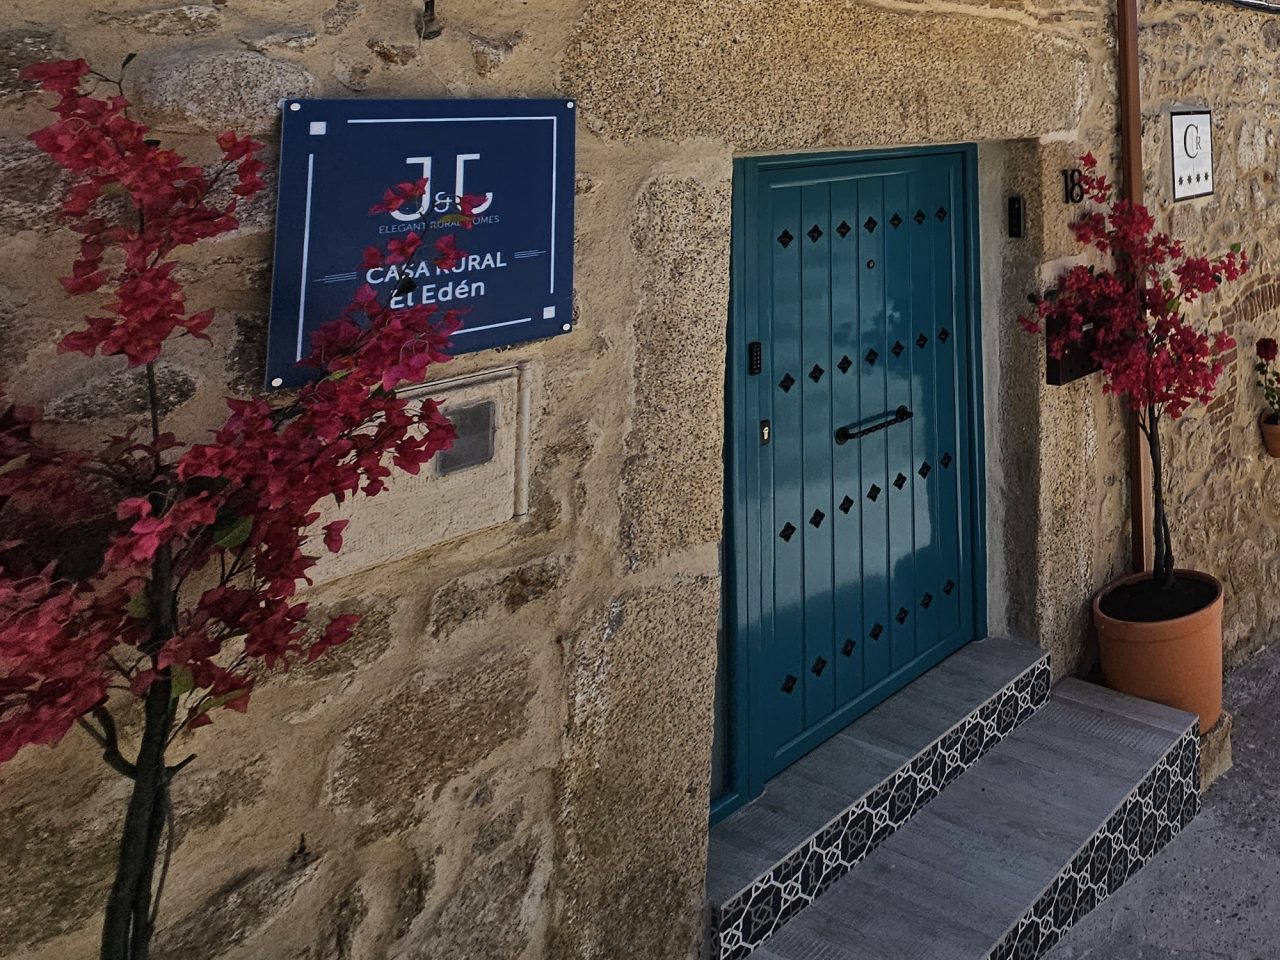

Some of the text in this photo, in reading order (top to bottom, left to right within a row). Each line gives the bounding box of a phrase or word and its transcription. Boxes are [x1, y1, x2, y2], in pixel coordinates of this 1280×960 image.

[1060, 169, 1084, 205] 18
[379, 222, 426, 234] ELEGANT
[366, 260, 431, 284] CASA
[421, 279, 485, 305] Edén
